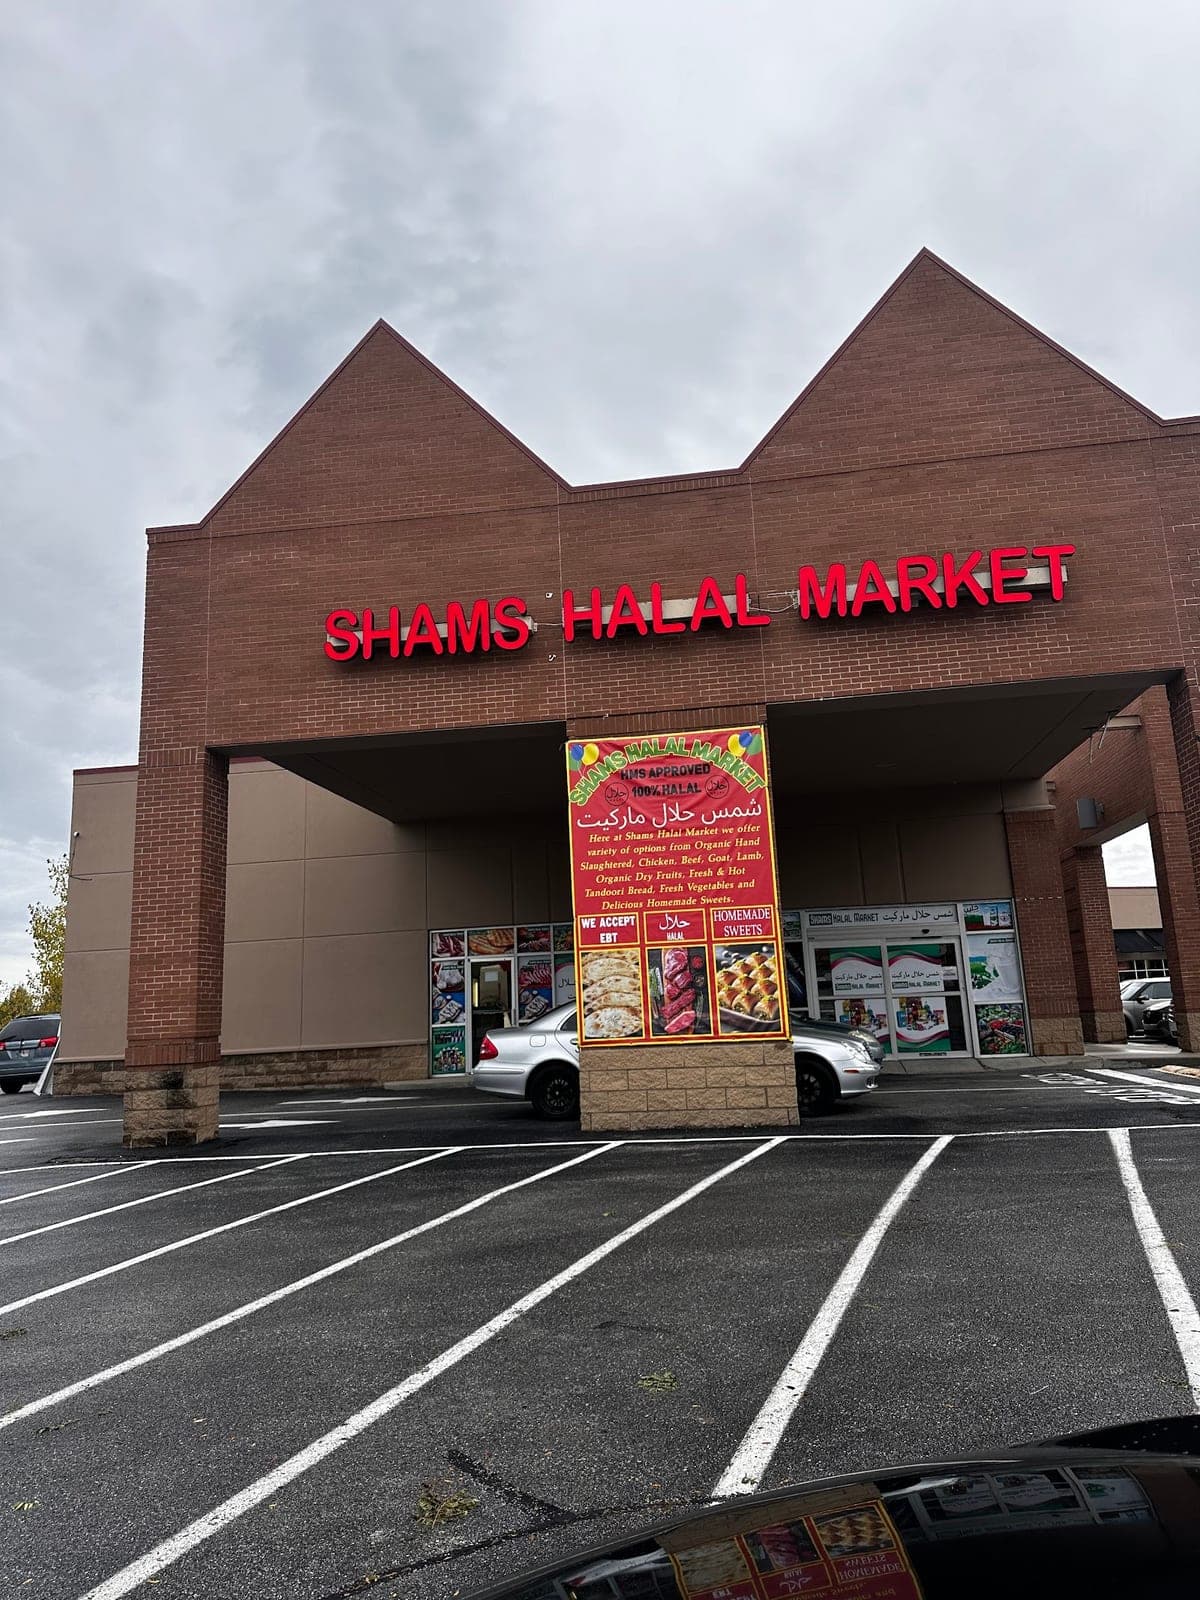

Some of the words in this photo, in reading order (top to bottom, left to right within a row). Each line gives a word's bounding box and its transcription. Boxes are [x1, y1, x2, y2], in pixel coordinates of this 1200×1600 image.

[324, 596, 531, 661] SHAMS
[563, 574, 770, 641] HALAL
[799, 544, 1075, 620] MARKET
[570, 751, 628, 806] SHAMS
[625, 737, 689, 762] HALAL
[691, 740, 765, 793] MARKET
[621, 768, 646, 780] HMS
[649, 763, 711, 778] APPROVED
[632, 786, 661, 797] 100%
[662, 782, 702, 796] HALAL
[577, 807, 645, 831] ماركيت
[652, 802, 695, 828] حلال
[701, 798, 762, 824] شمس
[589, 834, 610, 842] Here
[625, 832, 654, 840] Shams
[658, 830, 681, 838] Halal
[685, 828, 718, 837] Market
[737, 825, 760, 833] offer
[587, 847, 617, 857] variety
[621, 846, 630, 854] of
[633, 844, 666, 854] options
[670, 842, 691, 850] from
[695, 840, 731, 851] Organic
[736, 838, 760, 846] Hand
[580, 860, 635, 871] Slaughtered,
[596, 874, 632, 884] Organic
[636, 873, 653, 882] Dry
[656, 871, 685, 880] Fruits,
[689, 869, 713, 877] Fresh
[717, 867, 724, 875] &
[728, 866, 746, 875] Hot
[585, 888, 624, 897] Tandoori
[627, 885, 656, 895] Bread,
[660, 884, 683, 892] Fresh
[687, 881, 734, 892] Vegetables
[738, 879, 755, 888] and
[602, 901, 643, 910] Delicious
[647, 898, 696, 908] Homemade
[700, 896, 734, 904] Sweets.
[581, 919, 598, 928] WE
[599, 916, 636, 928] ACCEPT
[659, 913, 691, 930] حلال
[714, 908, 771, 921] HOMEMADE
[600, 933, 617, 943] EBT
[724, 924, 763, 936] SWEETS
